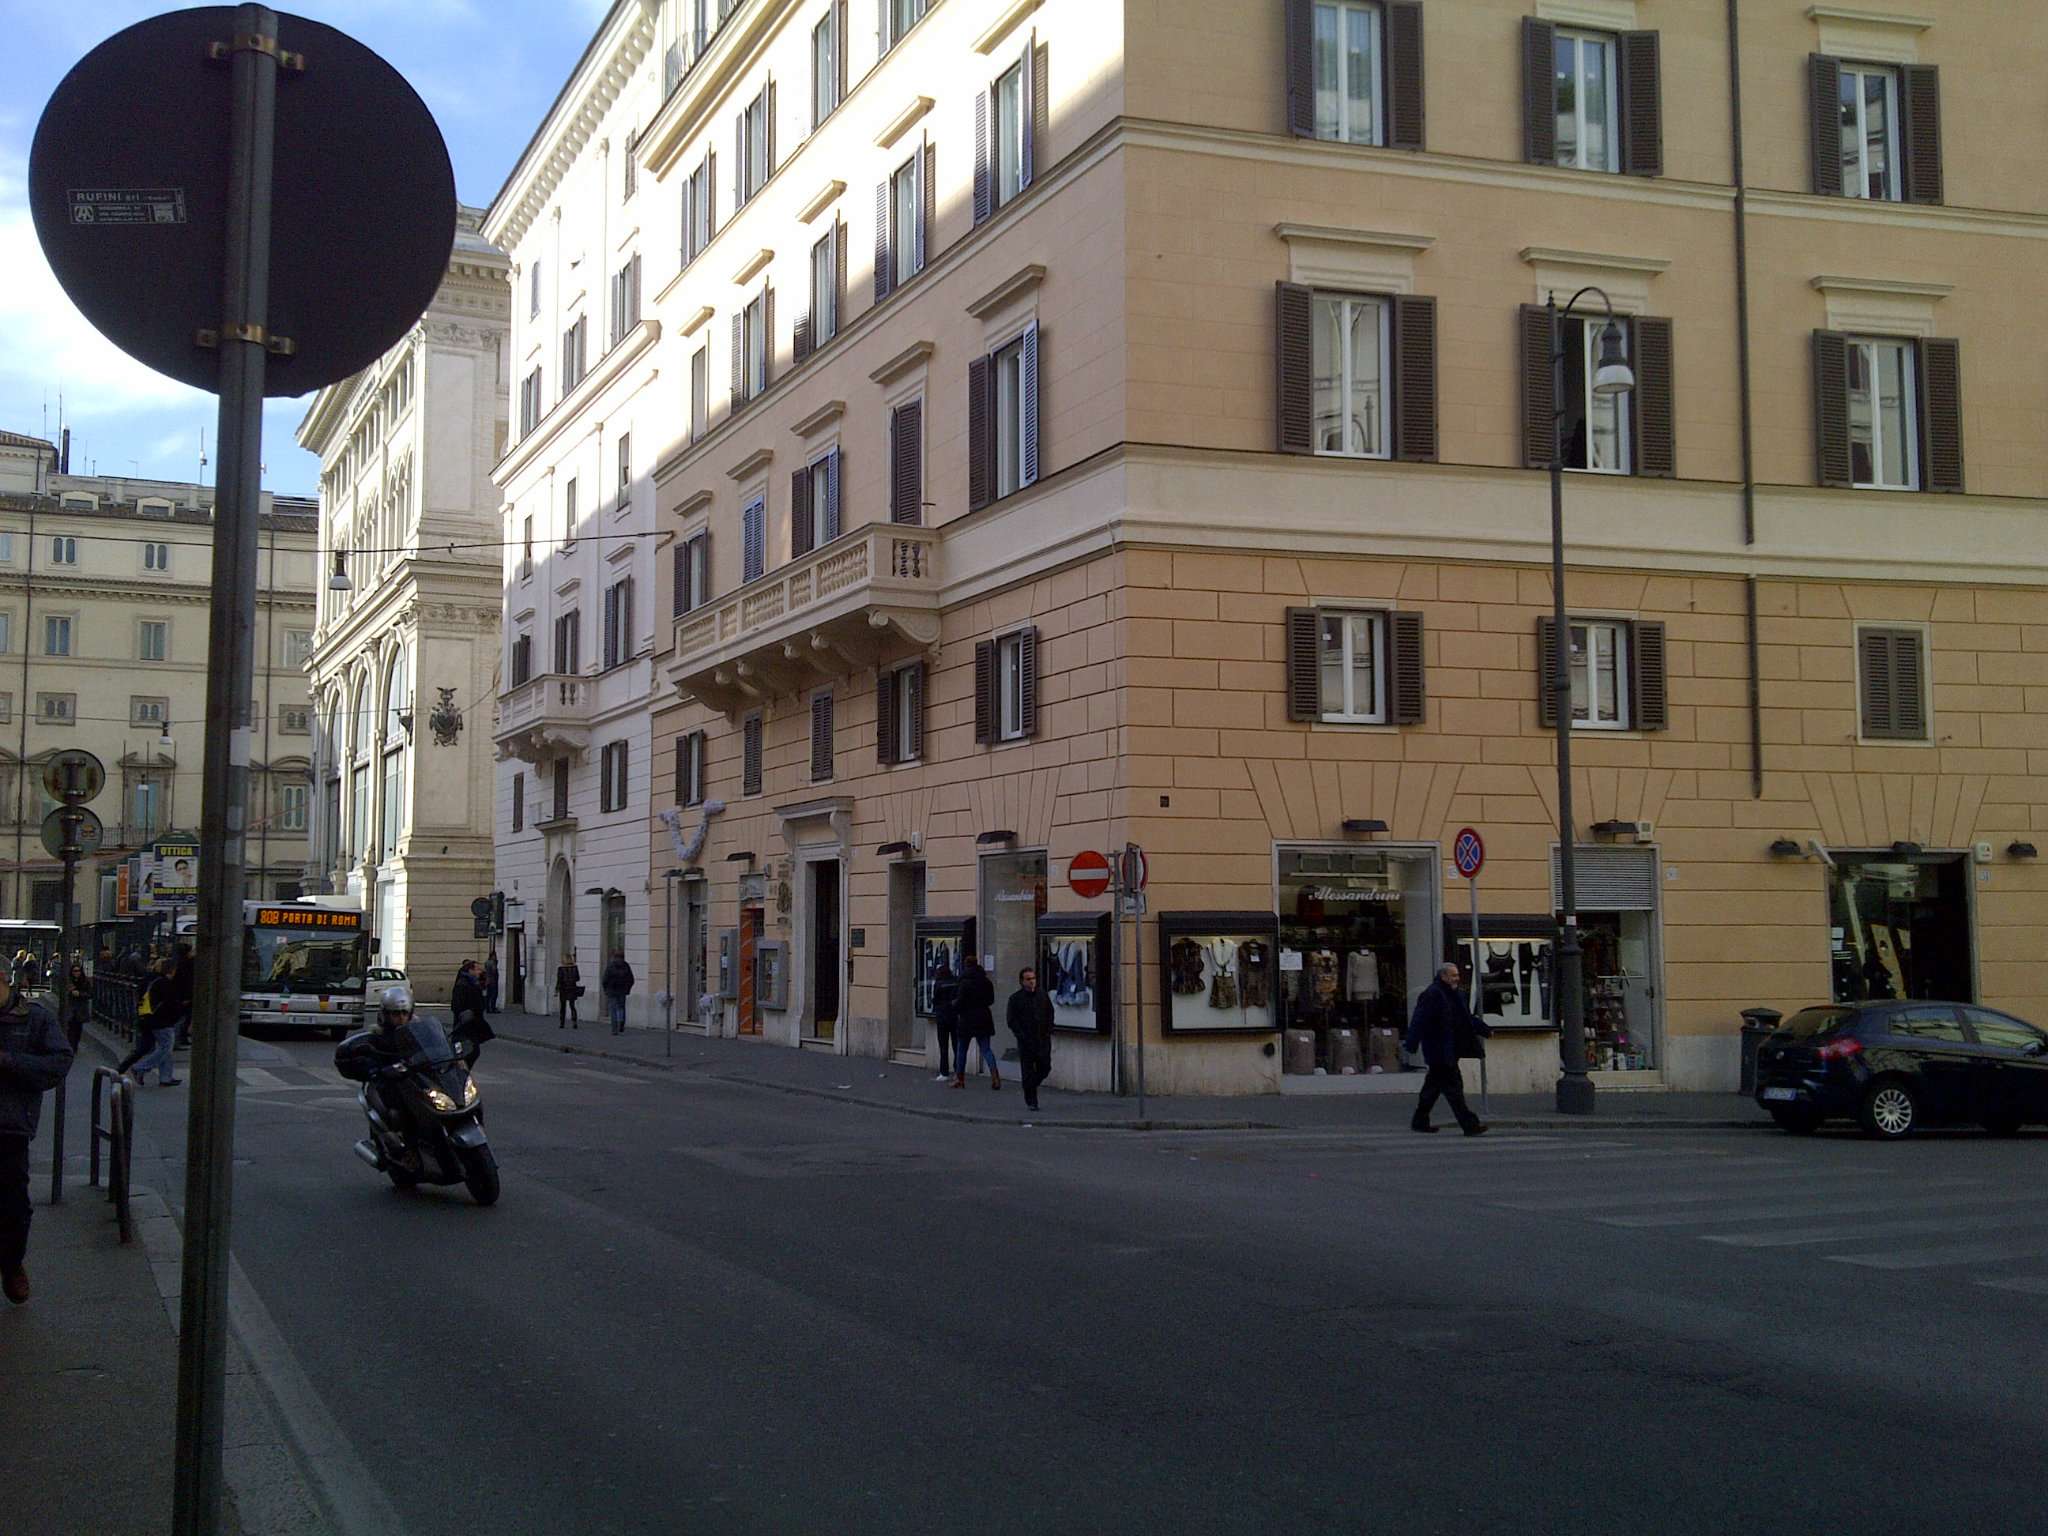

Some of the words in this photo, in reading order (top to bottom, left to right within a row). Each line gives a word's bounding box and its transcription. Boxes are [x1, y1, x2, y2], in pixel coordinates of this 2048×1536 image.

[77, 192, 121, 201] RUFINI
[160, 846, 193, 856] OTTICA
[282, 912, 313, 924] PORTA
[317, 914, 328, 925] DI
[332, 915, 357, 926] ROMA
